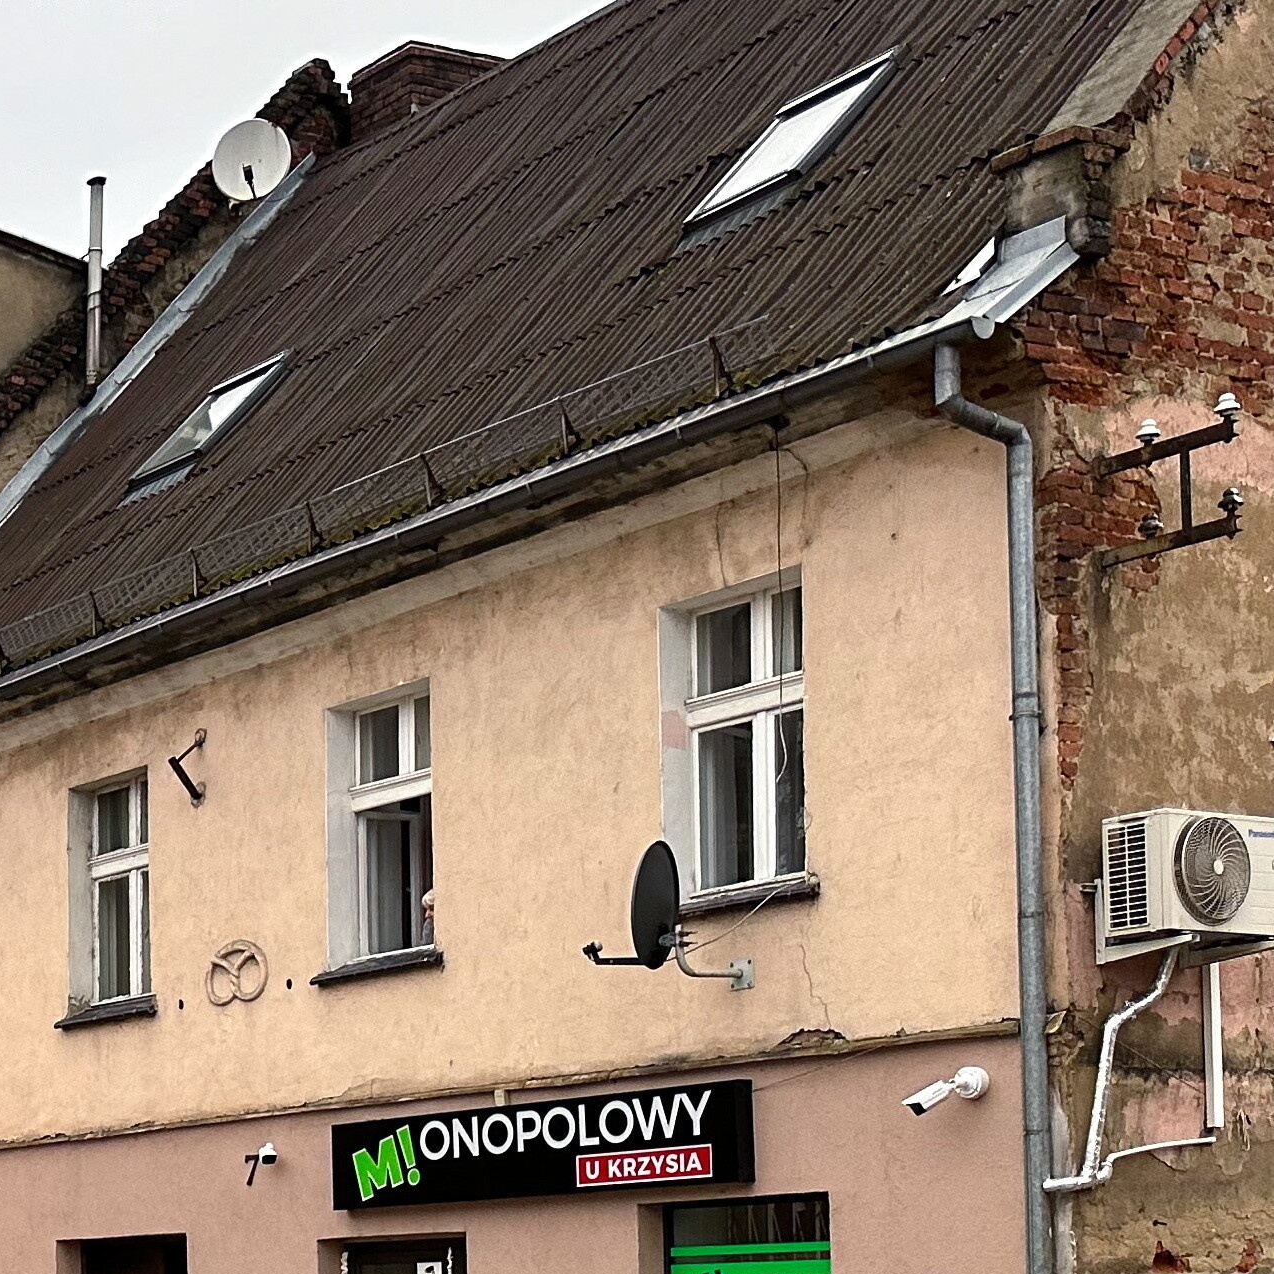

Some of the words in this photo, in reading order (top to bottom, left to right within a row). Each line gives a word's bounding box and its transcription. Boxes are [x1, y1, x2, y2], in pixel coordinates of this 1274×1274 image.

[244, 1154, 259, 1187] 7
[585, 1160, 600, 1180] U
[608, 1152, 702, 1178] KRZYSIA
